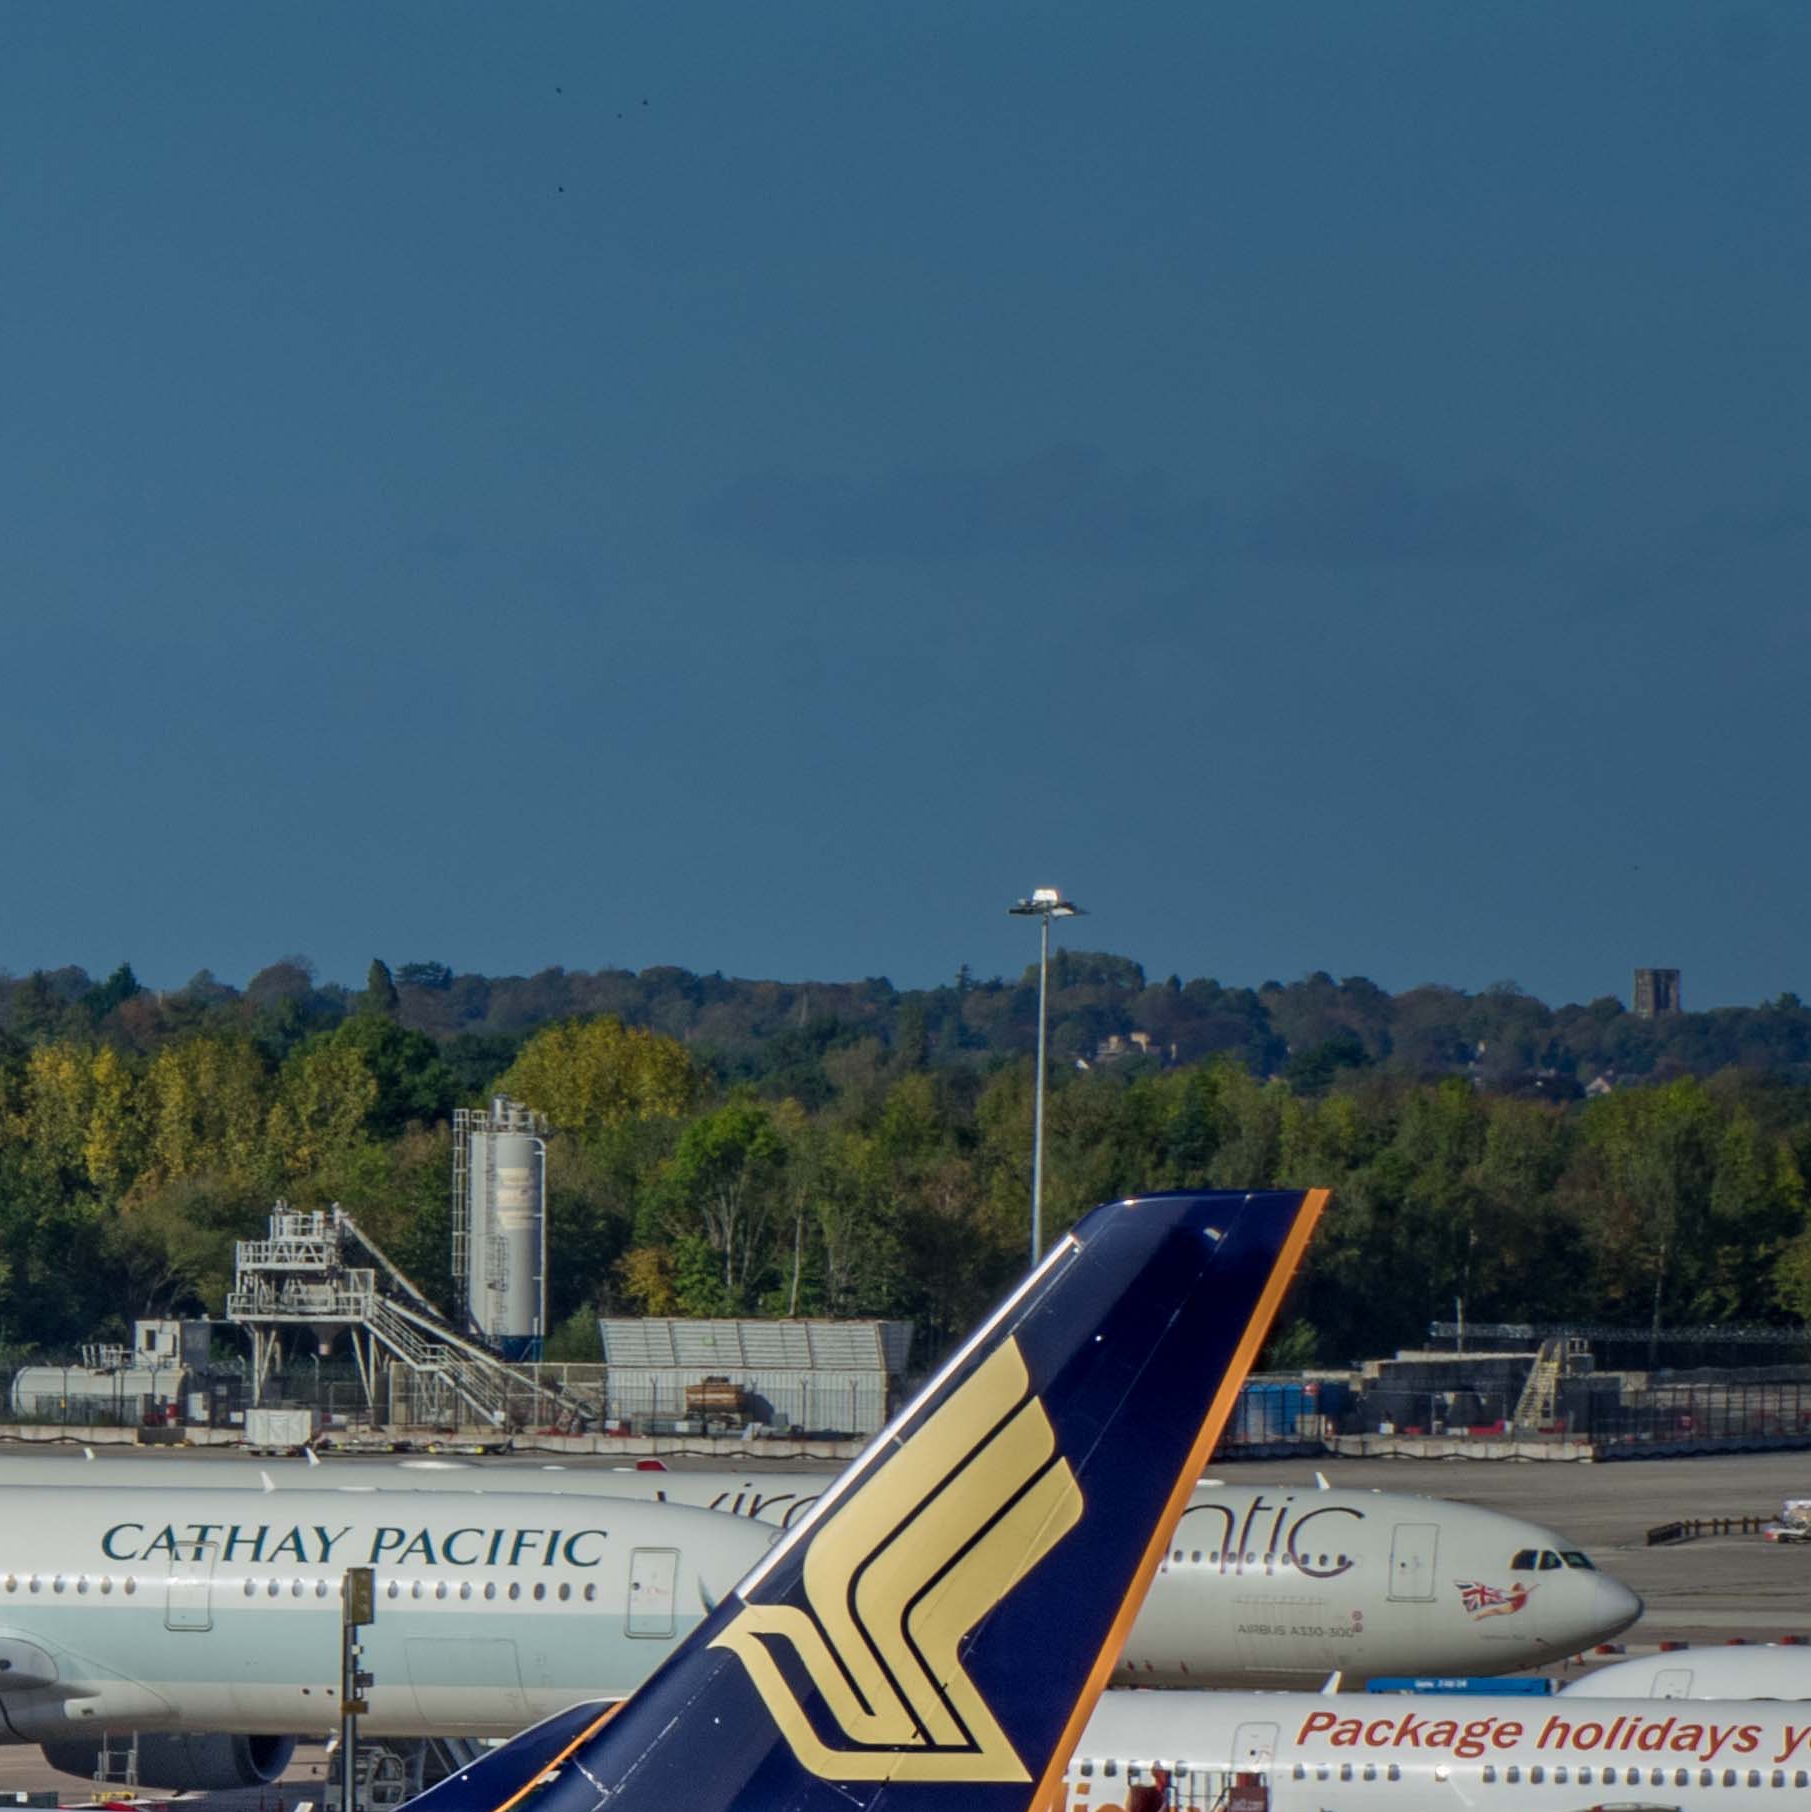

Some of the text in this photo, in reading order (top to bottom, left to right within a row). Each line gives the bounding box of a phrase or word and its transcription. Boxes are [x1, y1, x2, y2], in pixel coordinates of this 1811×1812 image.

[100, 1521, 609, 1568] CATHAY PACIFIC
[1160, 1496, 1366, 1579] ntic
[1237, 1623, 1287, 1636] AIRBUS
[1295, 1710, 1811, 1764] Package holidays y
